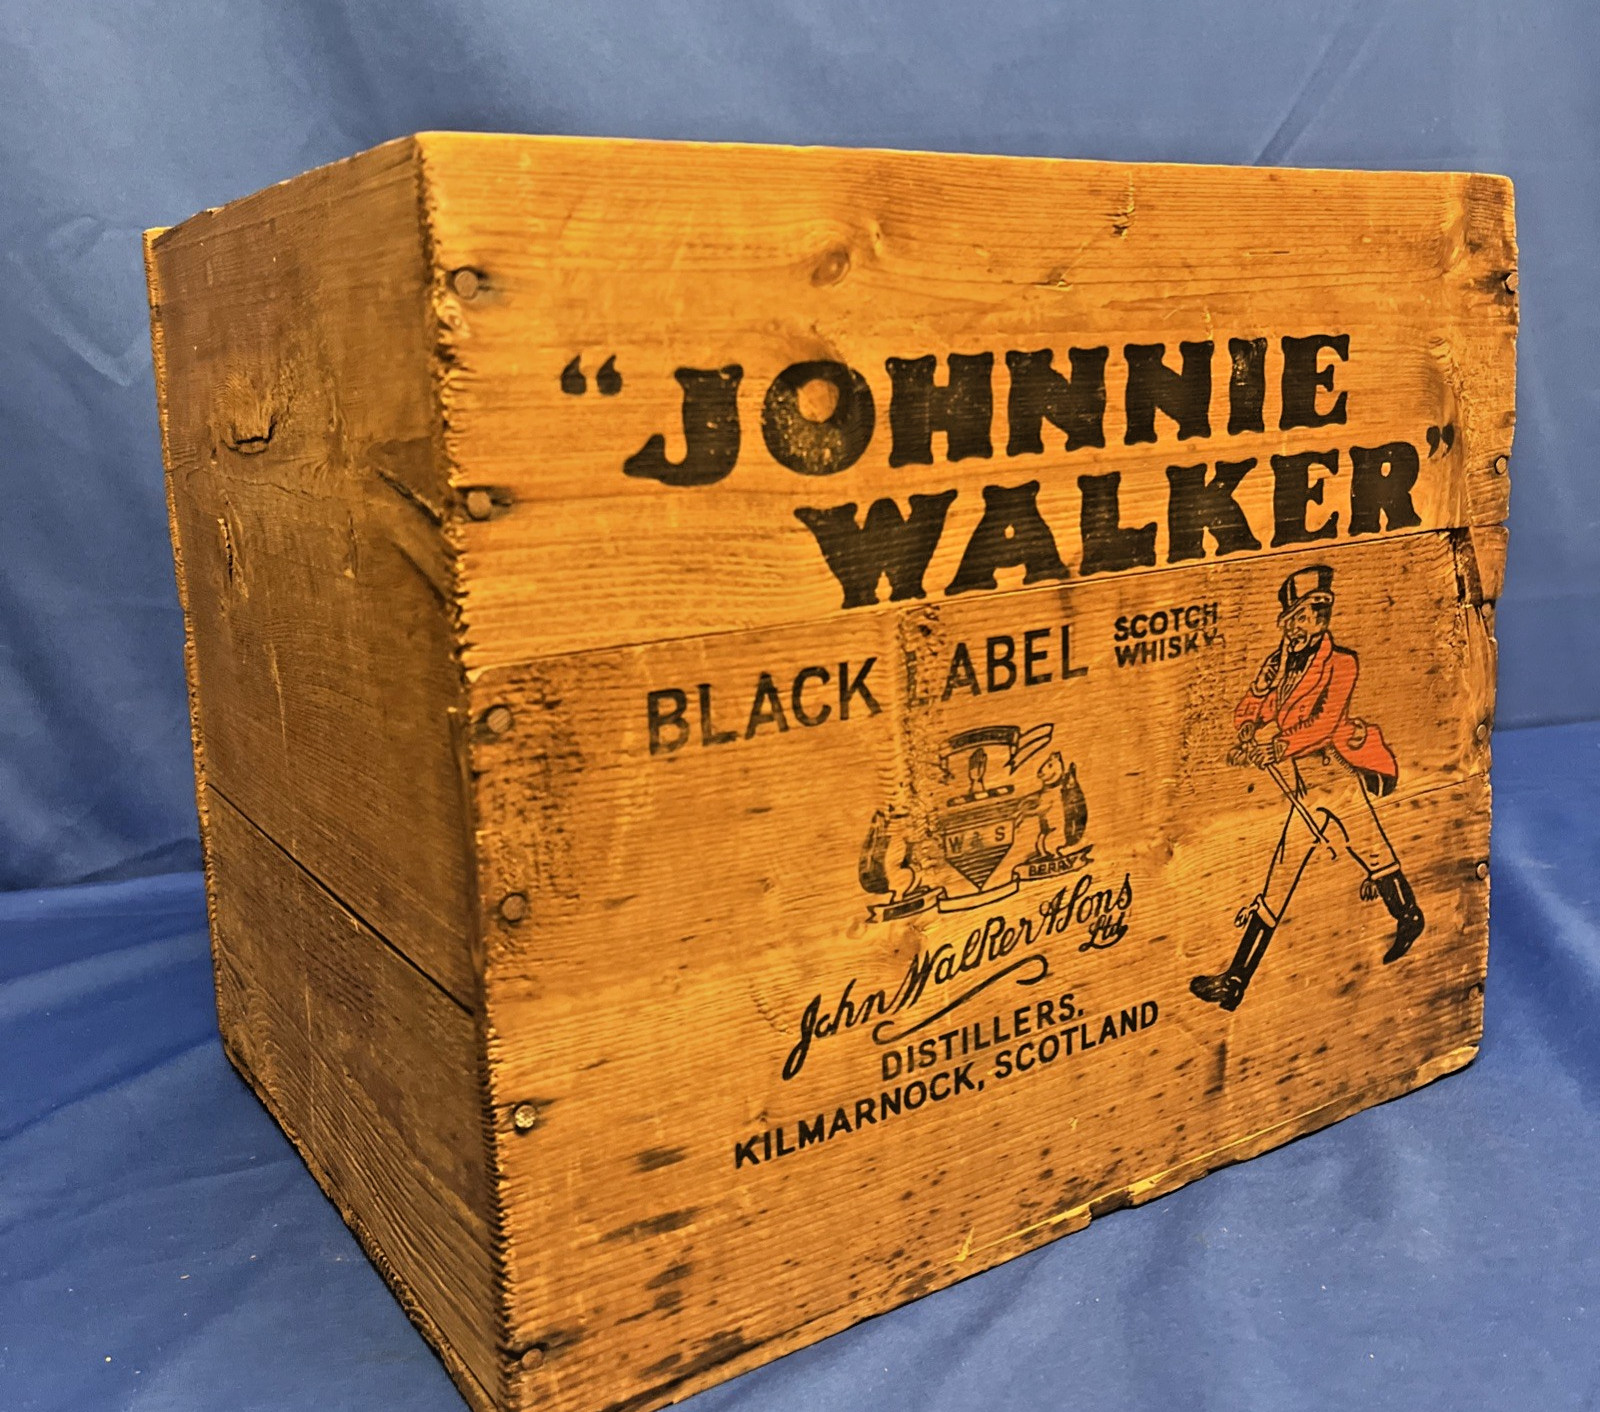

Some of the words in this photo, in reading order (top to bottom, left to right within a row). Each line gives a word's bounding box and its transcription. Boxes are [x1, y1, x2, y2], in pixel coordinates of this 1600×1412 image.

[1114, 602, 1218, 642] SCOTCH
[1114, 627, 1218, 668] WHISKY
[647, 657, 883, 756] BLACK
[994, 825, 1005, 842] S
[782, 978, 896, 1080] John
[1056, 873, 1132, 934] Sons
[734, 1060, 985, 1169] KILMARNOCK,
[994, 1000, 1159, 1079] SCOTLAND
